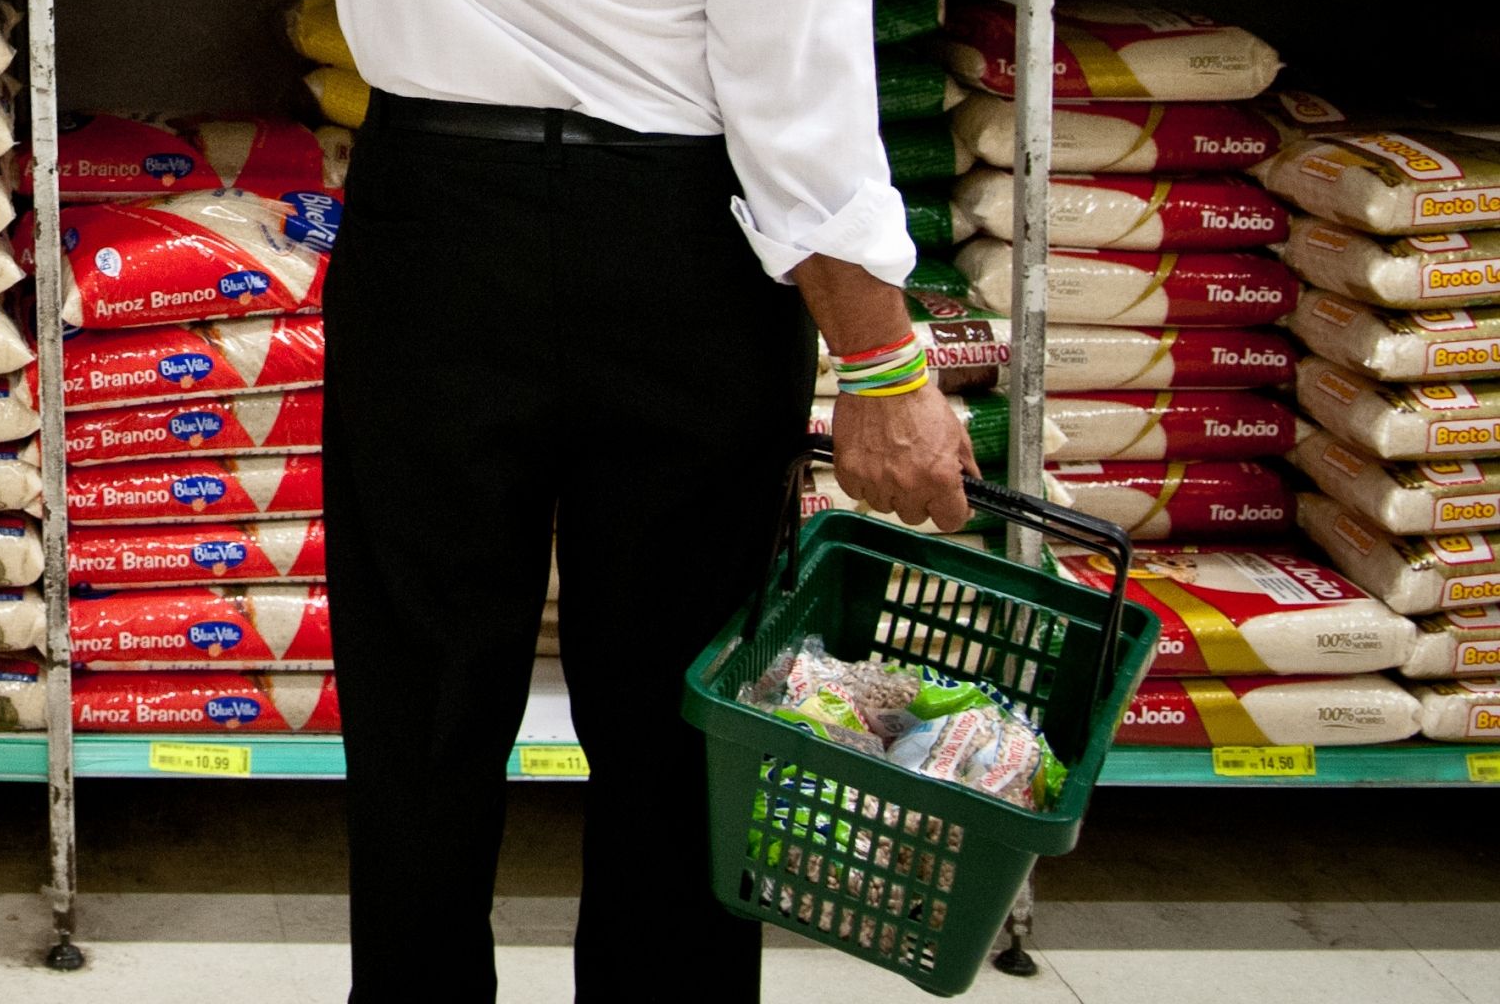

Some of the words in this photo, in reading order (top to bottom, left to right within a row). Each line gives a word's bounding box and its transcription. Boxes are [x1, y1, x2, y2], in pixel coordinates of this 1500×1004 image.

[1194, 136, 1219, 153] Tio
[1221, 136, 1266, 154] João
[78, 159, 140, 177] Branco
[1422, 198, 1476, 217] Broto
[1201, 210, 1228, 230] Tio
[1229, 211, 1275, 231] João
[96, 298, 145, 318] Arroz
[151, 287, 217, 309] Branco
[1206, 284, 1233, 302] Tio
[1235, 285, 1282, 303] João
[925, 344, 1011, 367] ROSALITO
[1435, 348, 1489, 367] Broto
[103, 487, 170, 506] Branco
[1316, 633, 1352, 649] 100%
[80, 704, 130, 723] Arroz
[137, 703, 203, 724] Branco
